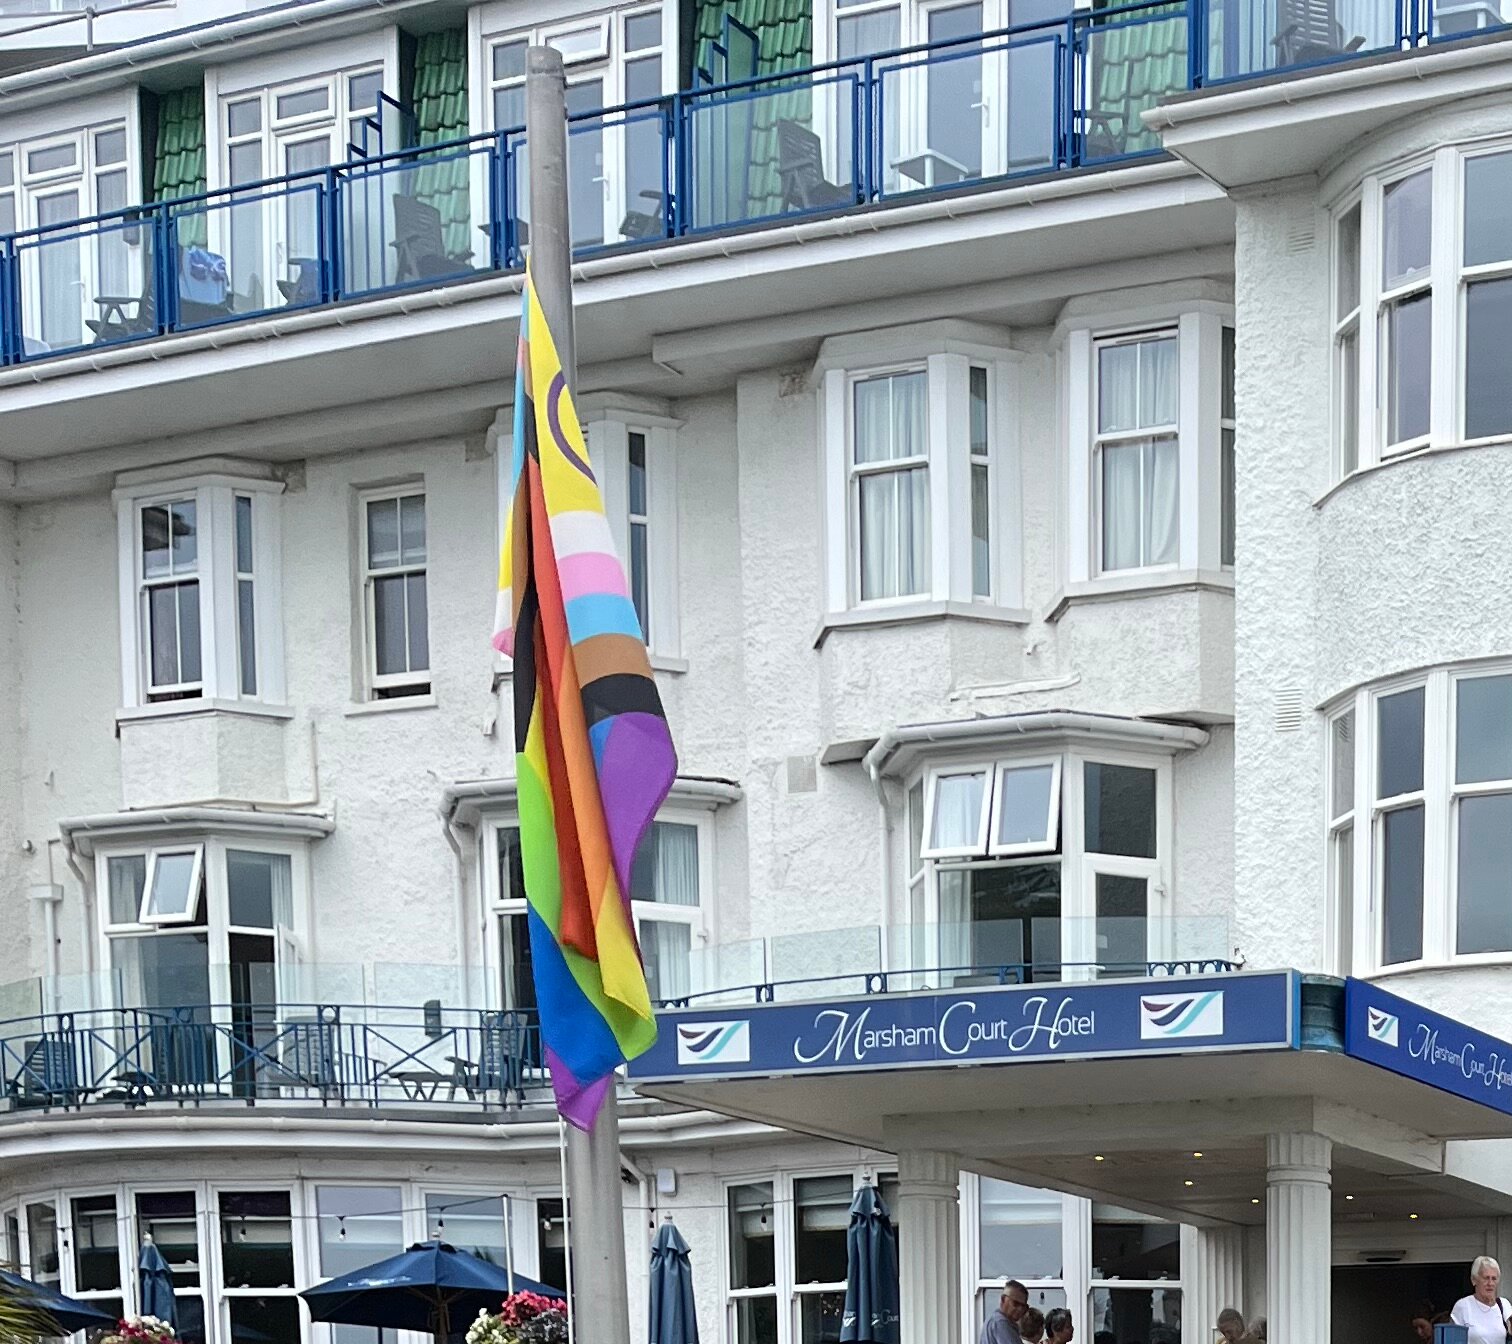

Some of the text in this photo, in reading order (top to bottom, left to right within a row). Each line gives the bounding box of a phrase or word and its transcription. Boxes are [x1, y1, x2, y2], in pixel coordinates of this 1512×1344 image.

[793, 997, 1095, 1063] Marsham Court Hotel
[1408, 1023, 1461, 1065] Marsham
